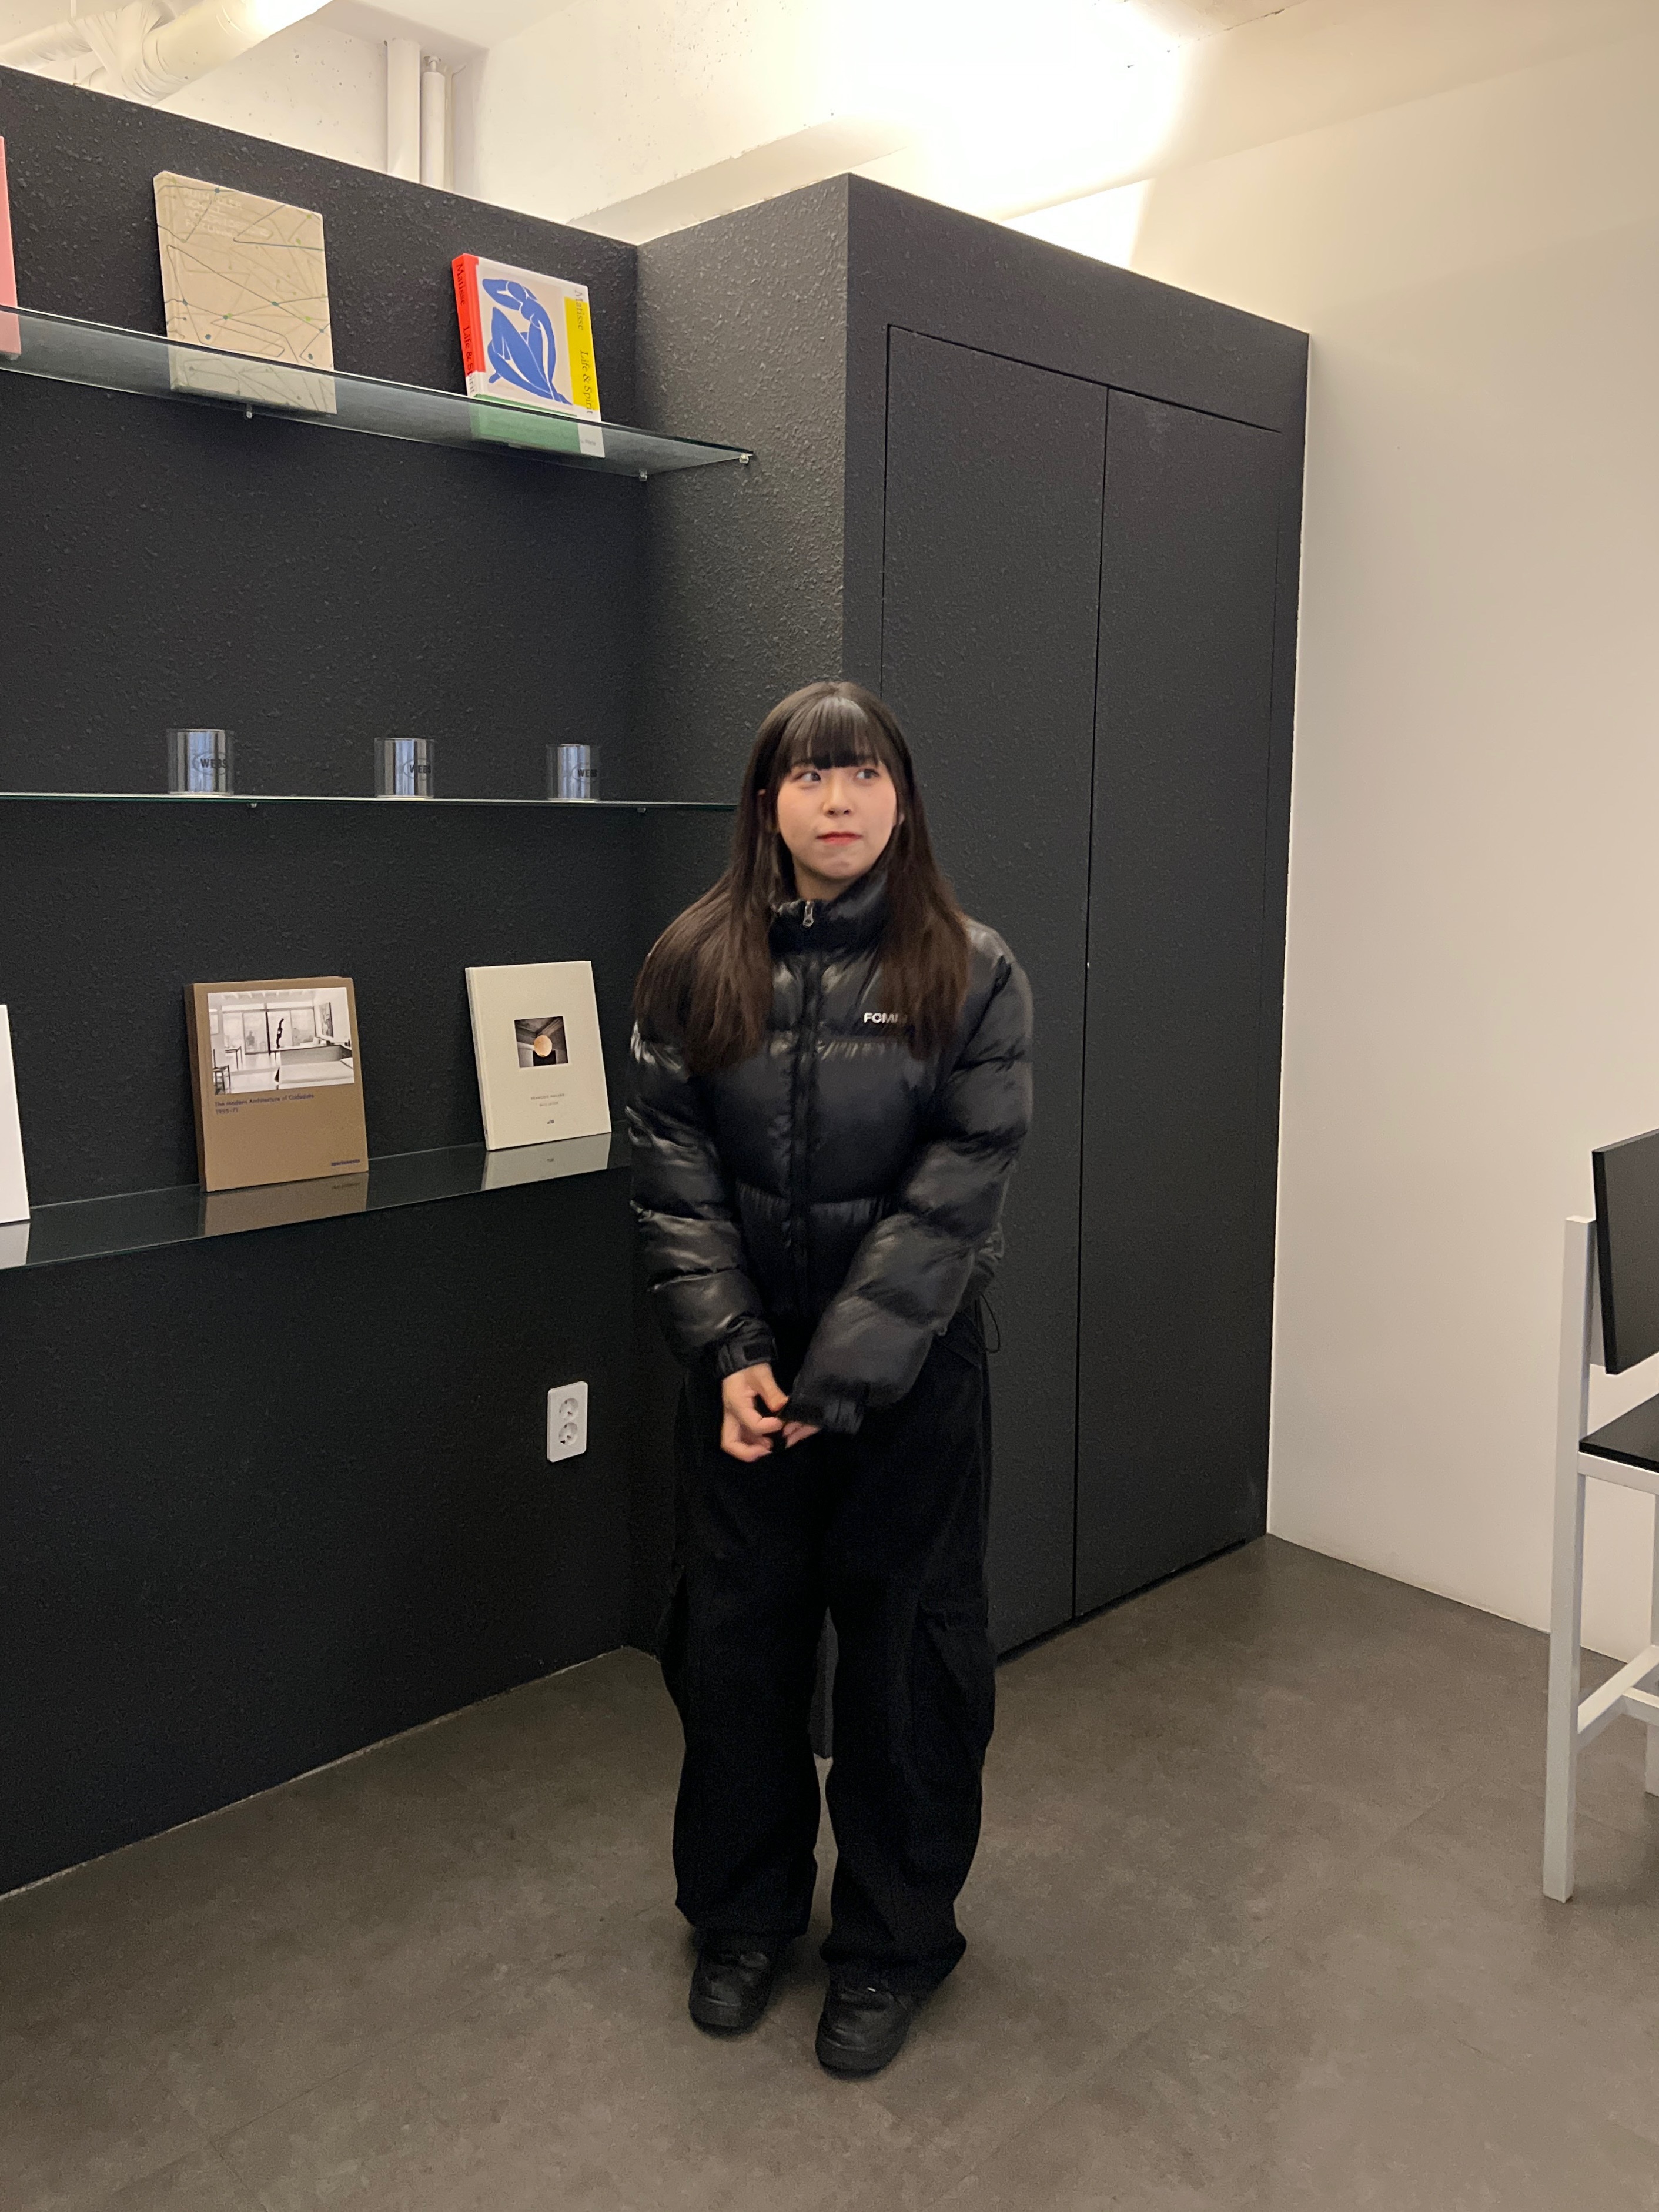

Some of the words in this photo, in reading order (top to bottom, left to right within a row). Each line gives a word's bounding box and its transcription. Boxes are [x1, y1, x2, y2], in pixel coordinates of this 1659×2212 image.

[456, 263, 466, 306] Matisse
[574, 289, 586, 332] Matisse
[463, 325, 473, 348] Life
[466, 350, 473, 360] &
[580, 350, 590, 374] Life
[467, 361, 475, 394] Spirit
[583, 374, 591, 384] &
[583, 384, 593, 415] Spirit
